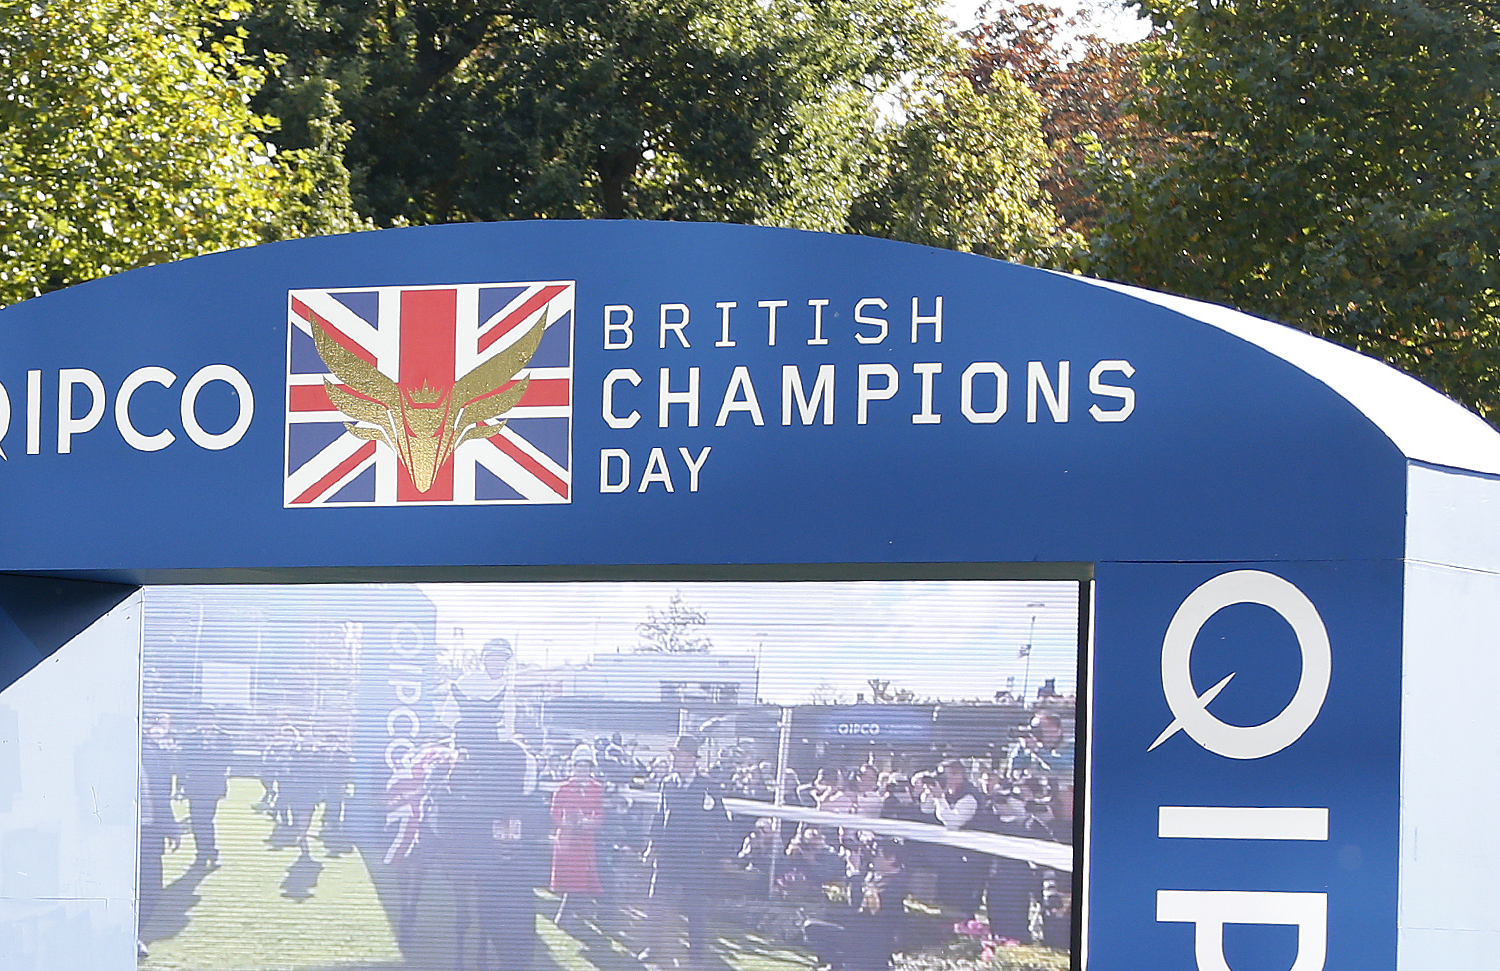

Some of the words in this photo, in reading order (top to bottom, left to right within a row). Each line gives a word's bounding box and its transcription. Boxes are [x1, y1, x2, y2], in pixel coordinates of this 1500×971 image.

[603, 296, 944, 350] BRITISH
[602, 359, 1136, 429] CHAMPIONS
[600, 446, 712, 494] DAY
